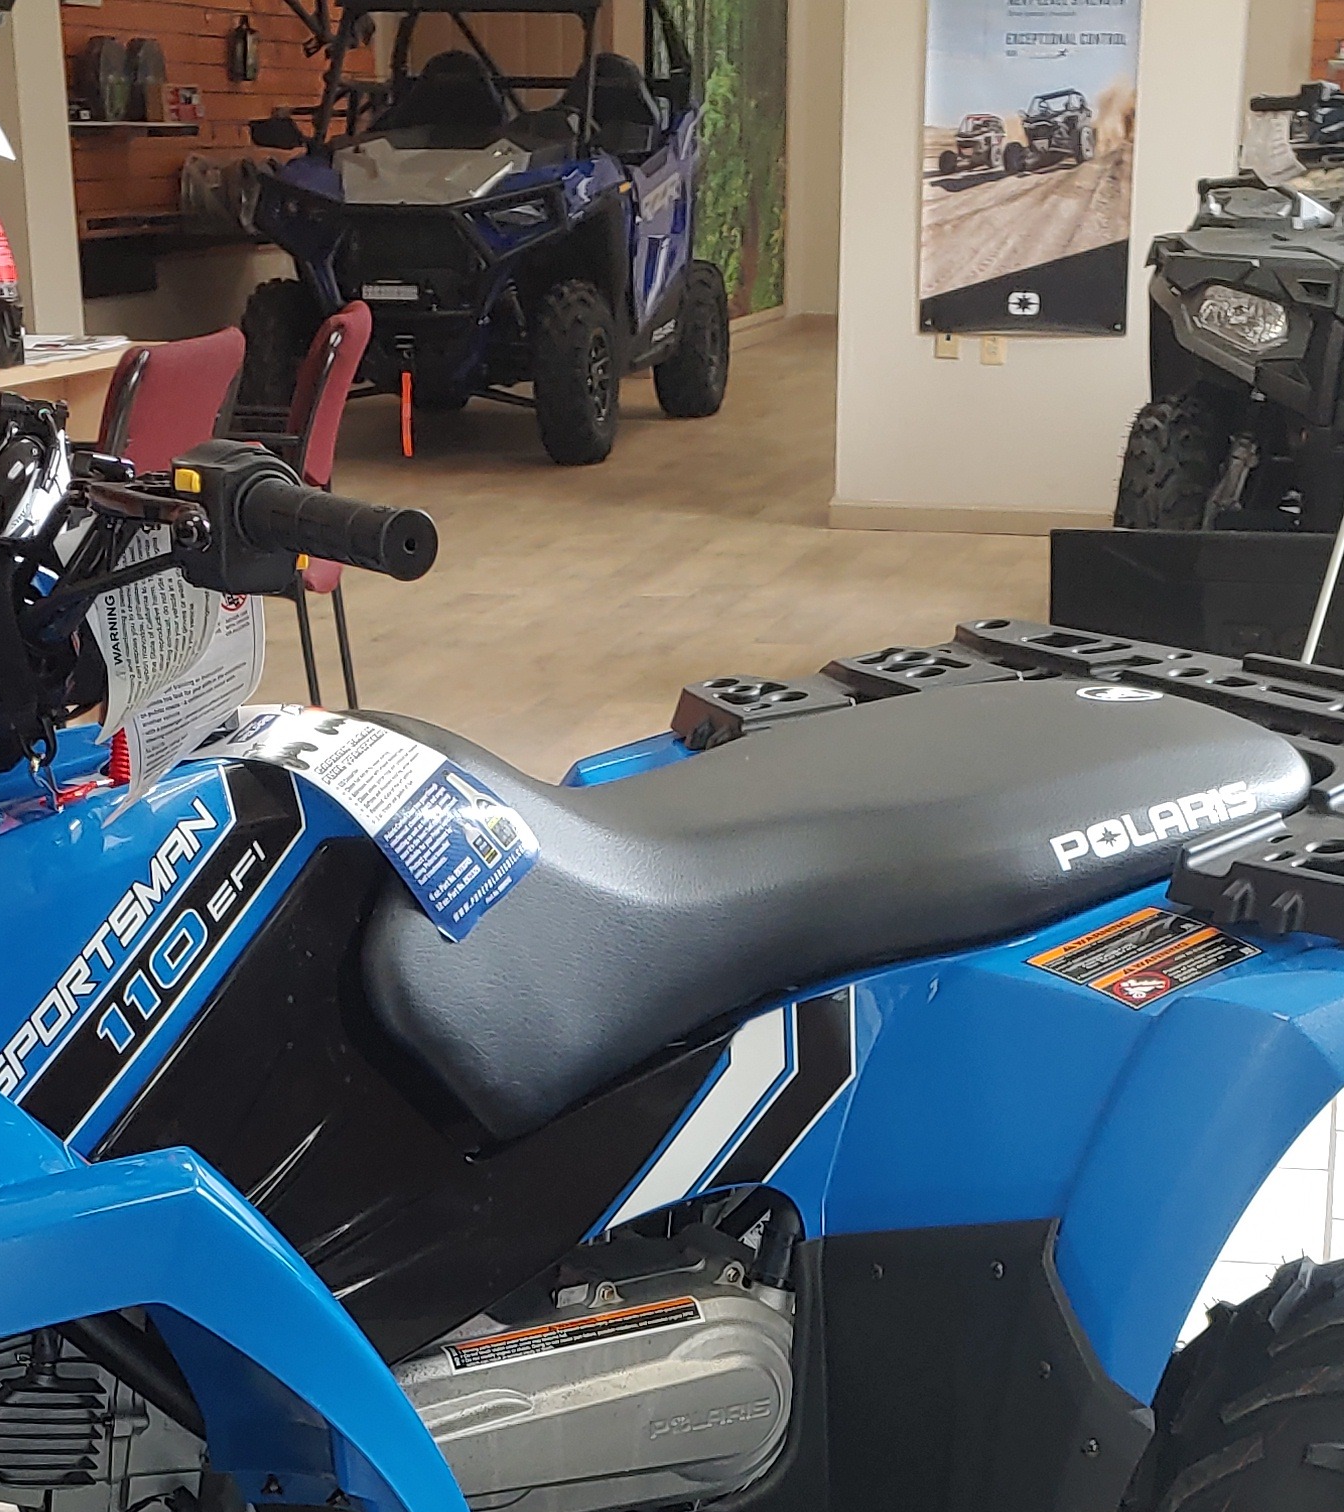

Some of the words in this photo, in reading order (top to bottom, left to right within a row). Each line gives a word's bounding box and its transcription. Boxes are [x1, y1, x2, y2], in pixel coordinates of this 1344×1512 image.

[105, 594, 125, 666] WARNING
[1049, 781, 1257, 871] POLARIS
[96, 908, 208, 1055] 110
[206, 840, 266, 922] EFI
[649, 1399, 772, 1440] POLARIS
